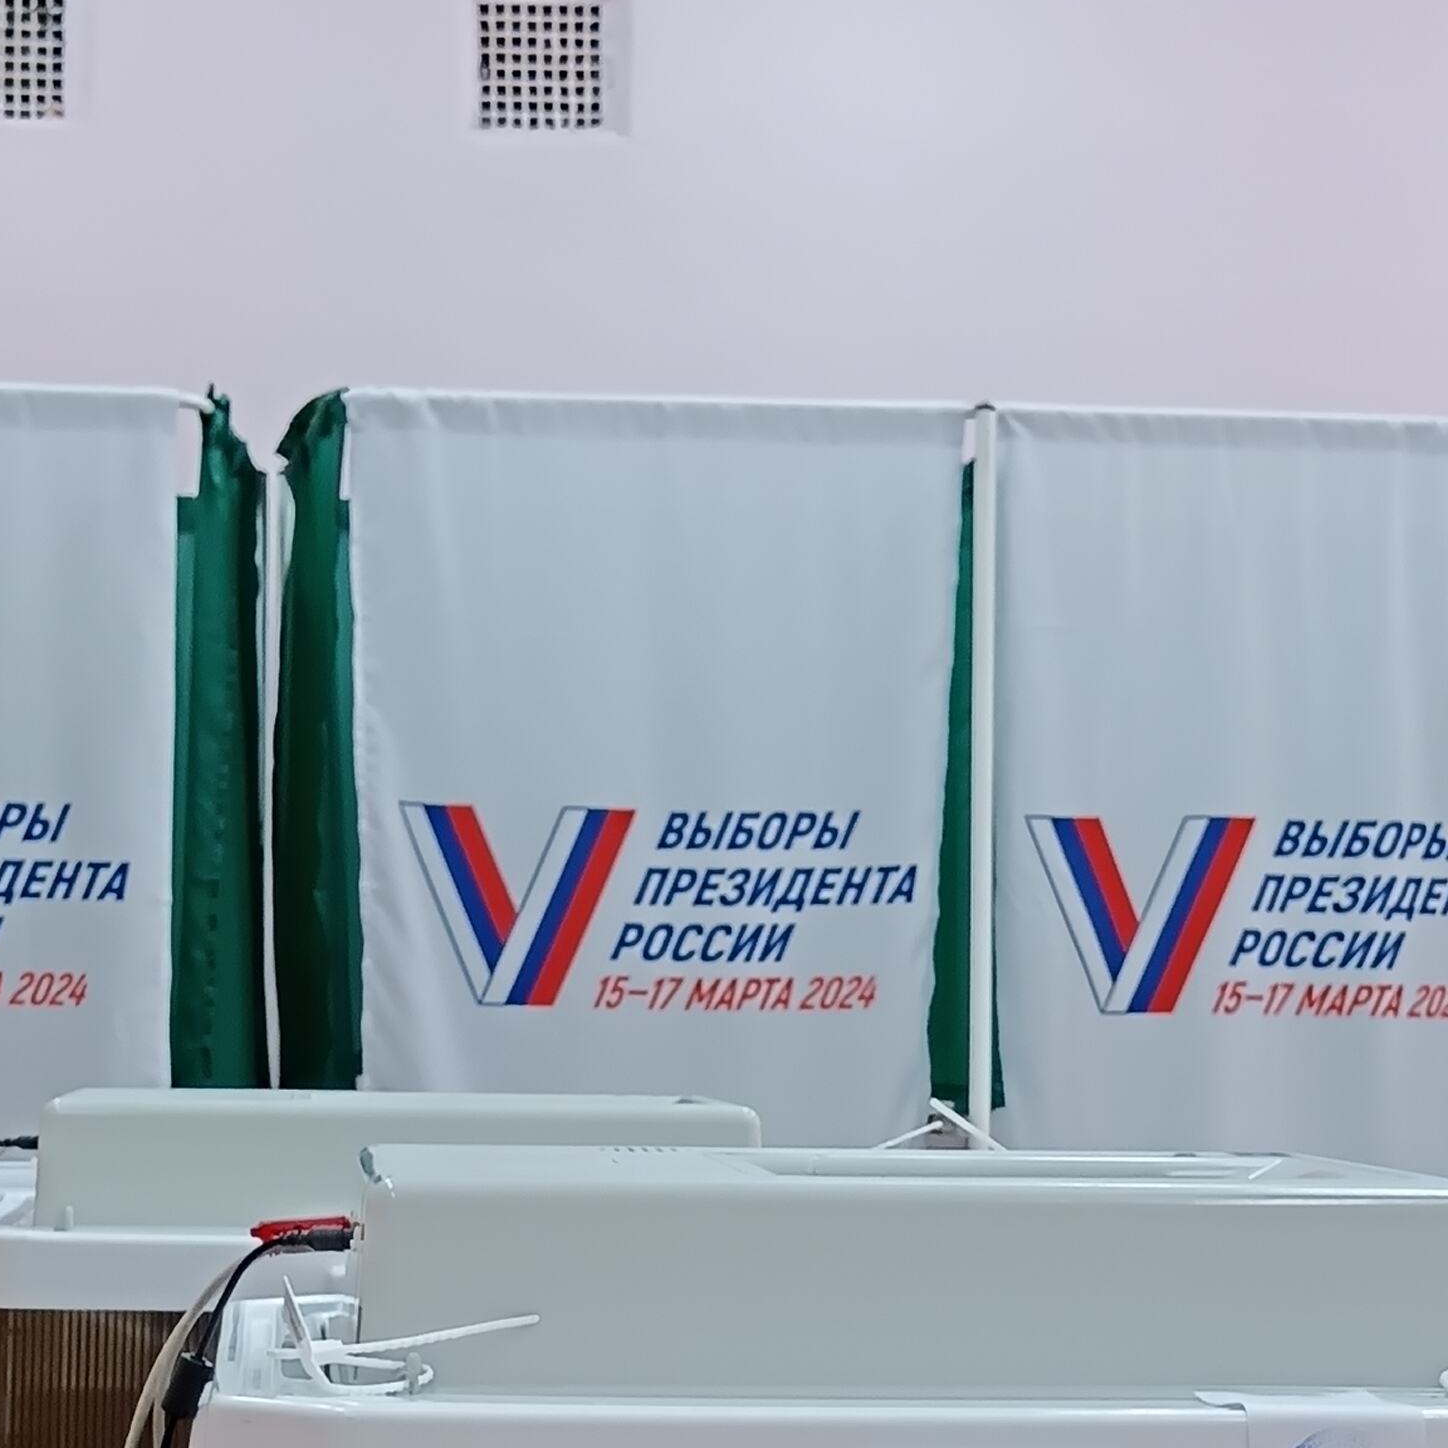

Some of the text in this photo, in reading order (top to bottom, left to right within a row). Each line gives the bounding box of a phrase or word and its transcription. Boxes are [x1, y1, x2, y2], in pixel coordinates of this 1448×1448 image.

[657, 810, 861, 850] ВЫБОРЫ
[633, 864, 918, 913] ПРЕЗИДЕНТА
[610, 923, 796, 962] РОССИИ
[1229, 929, 1406, 970] РОССИИ
[9, 972, 88, 1007] 2024
[685, 976, 791, 1011] МАРТА
[799, 975, 877, 1011] 2024
[1295, 983, 1404, 1018] МАРТА
